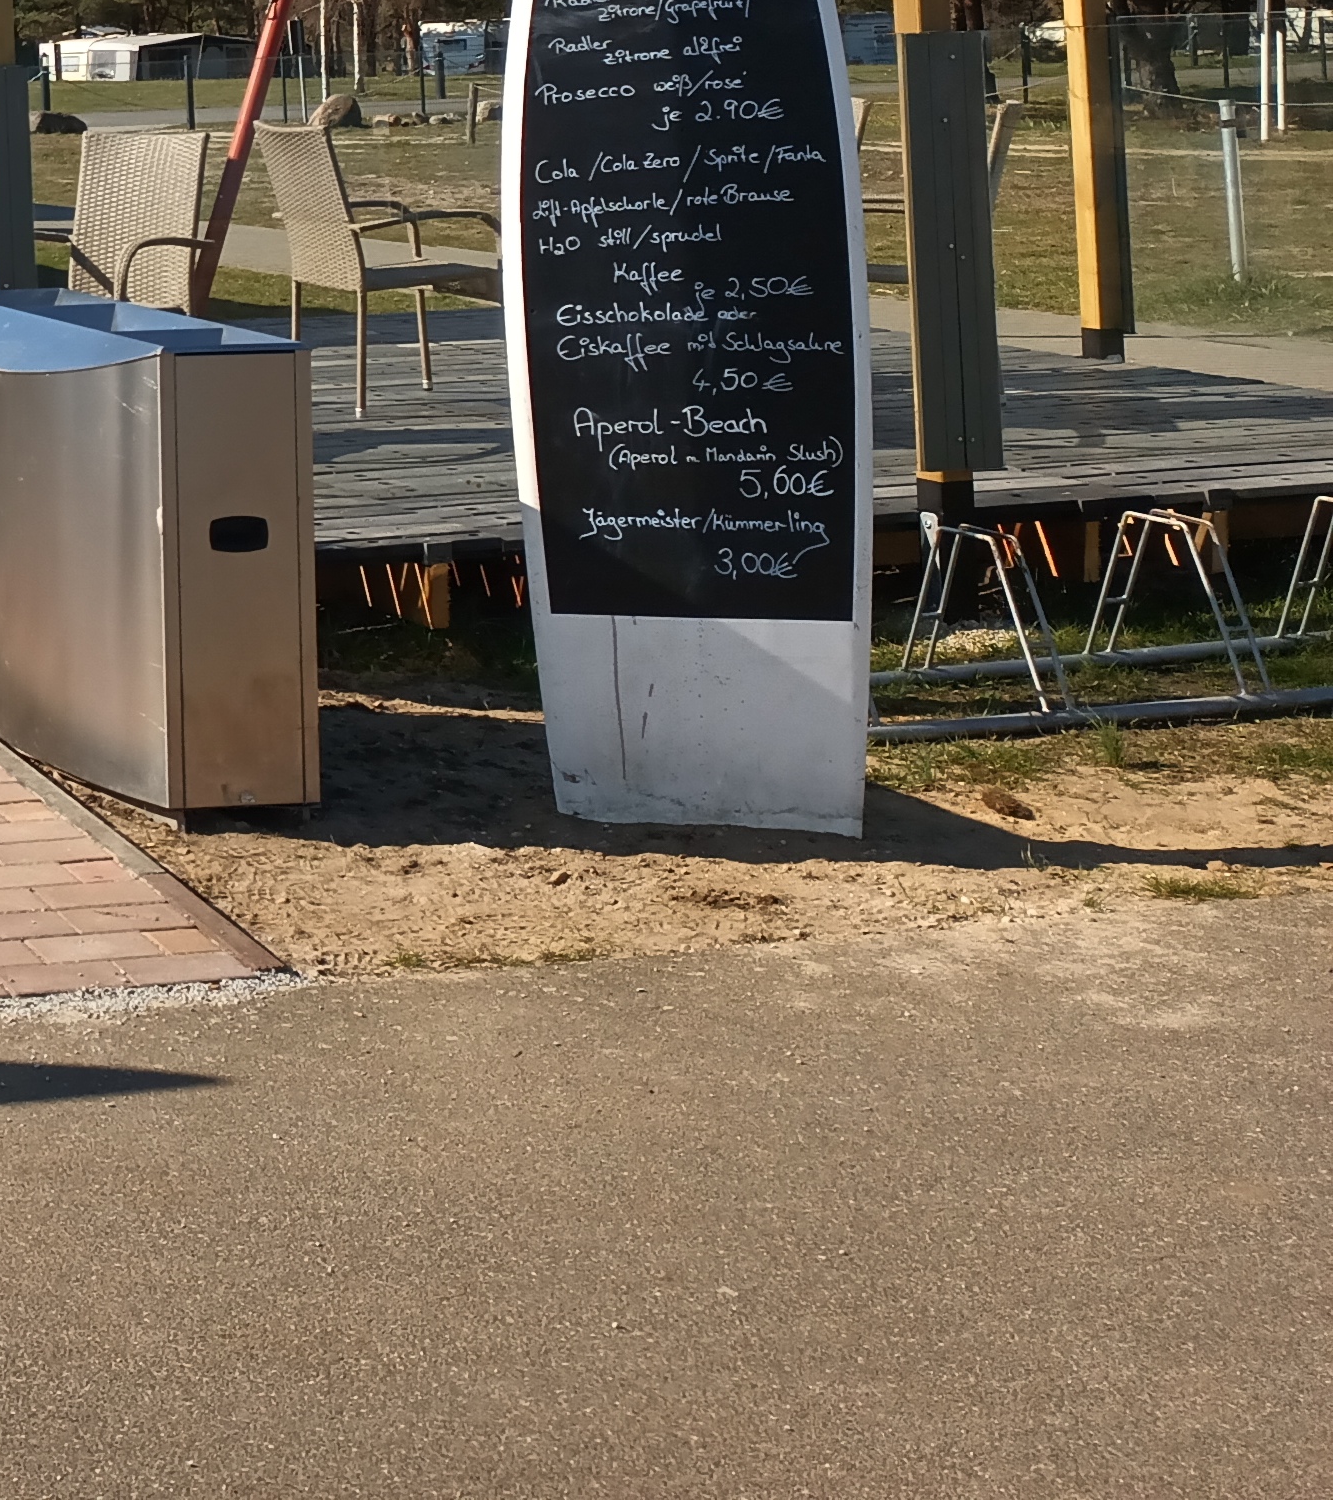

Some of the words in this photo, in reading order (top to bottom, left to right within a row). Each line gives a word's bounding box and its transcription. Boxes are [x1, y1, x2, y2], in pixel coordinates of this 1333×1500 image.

[548, 35, 613, 55] Radler
[534, 83, 635, 105] Prosecco
[651, 106, 682, 131] je
[535, 158, 581, 184] Cola
[643, 152, 681, 170] Zero
[686, 186, 718, 206] rote
[720, 184, 795, 204] Brause
[613, 262, 685, 296] Kaffee
[694, 282, 715, 313] je
[724, 276, 814, 300] 2,50€
[556, 302, 709, 326] Eisschokolade
[556, 332, 673, 372] Eiskaffee
[721, 332, 845, 364] Schlagsahne
